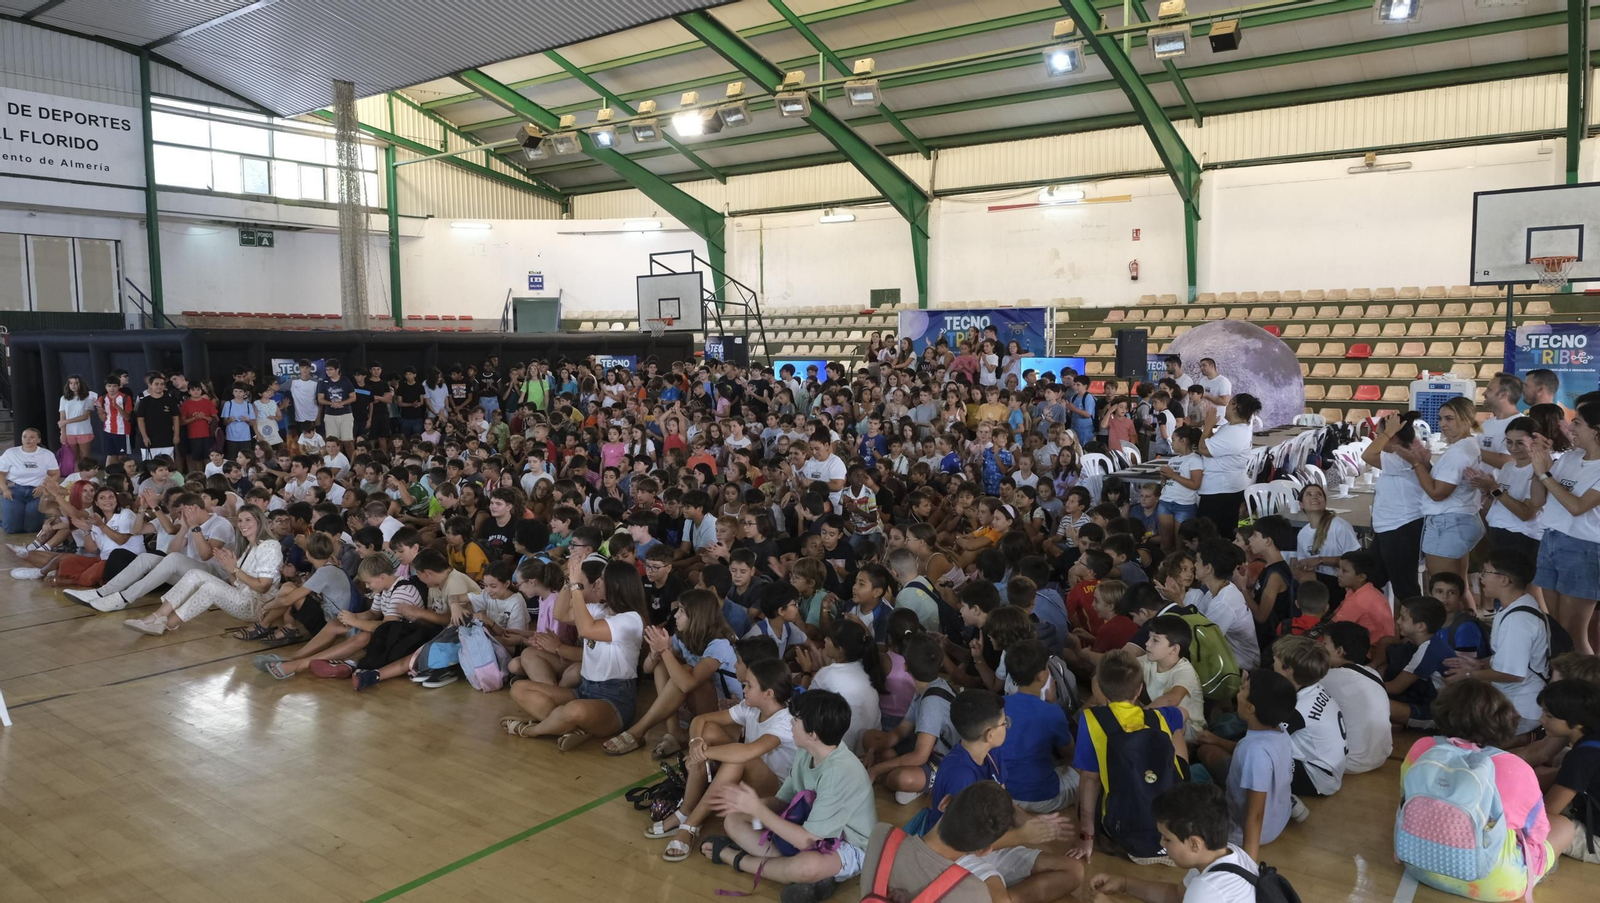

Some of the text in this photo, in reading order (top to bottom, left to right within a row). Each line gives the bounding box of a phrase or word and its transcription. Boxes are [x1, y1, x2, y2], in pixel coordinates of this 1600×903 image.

[8, 102, 131, 131] DE DEPORTES
[20, 130, 99, 151] FLORIDO
[39, 156, 54, 166] de
[60, 159, 110, 172] Almería
[261, 237, 270, 246] A
[944, 315, 990, 331] TECNO
[1528, 334, 1587, 349] TECNO
[601, 359, 630, 367] TECNO
[1530, 349, 1584, 365] TRIBU
[279, 363, 317, 374] TECO
[1147, 361, 1167, 370] TECN
